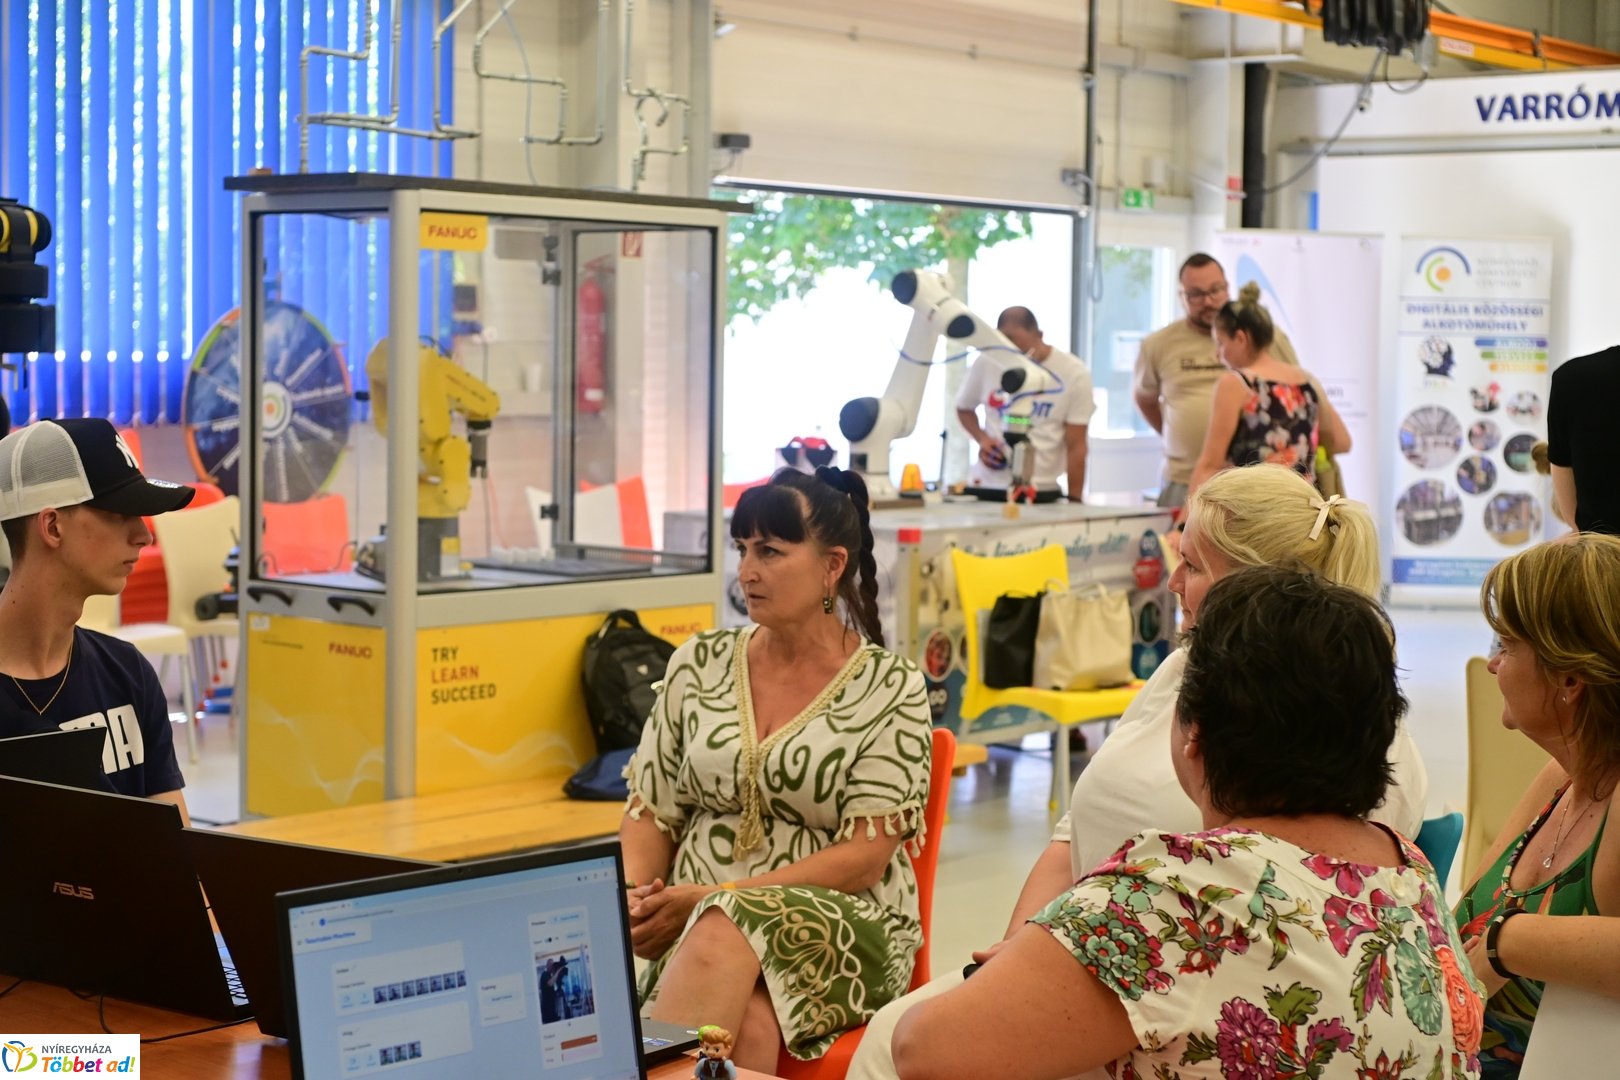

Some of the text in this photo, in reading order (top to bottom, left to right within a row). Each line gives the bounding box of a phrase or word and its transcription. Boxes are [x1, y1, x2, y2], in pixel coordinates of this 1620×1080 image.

[1476, 83, 1620, 122] VARRÓM
[428, 224, 478, 240] FANUC
[329, 642, 373, 659] FANUC
[432, 646, 459, 663] TRY
[431, 665, 480, 684] LEARN
[431, 682, 497, 705] SUCCEED
[53, 881, 95, 900] ASUS
